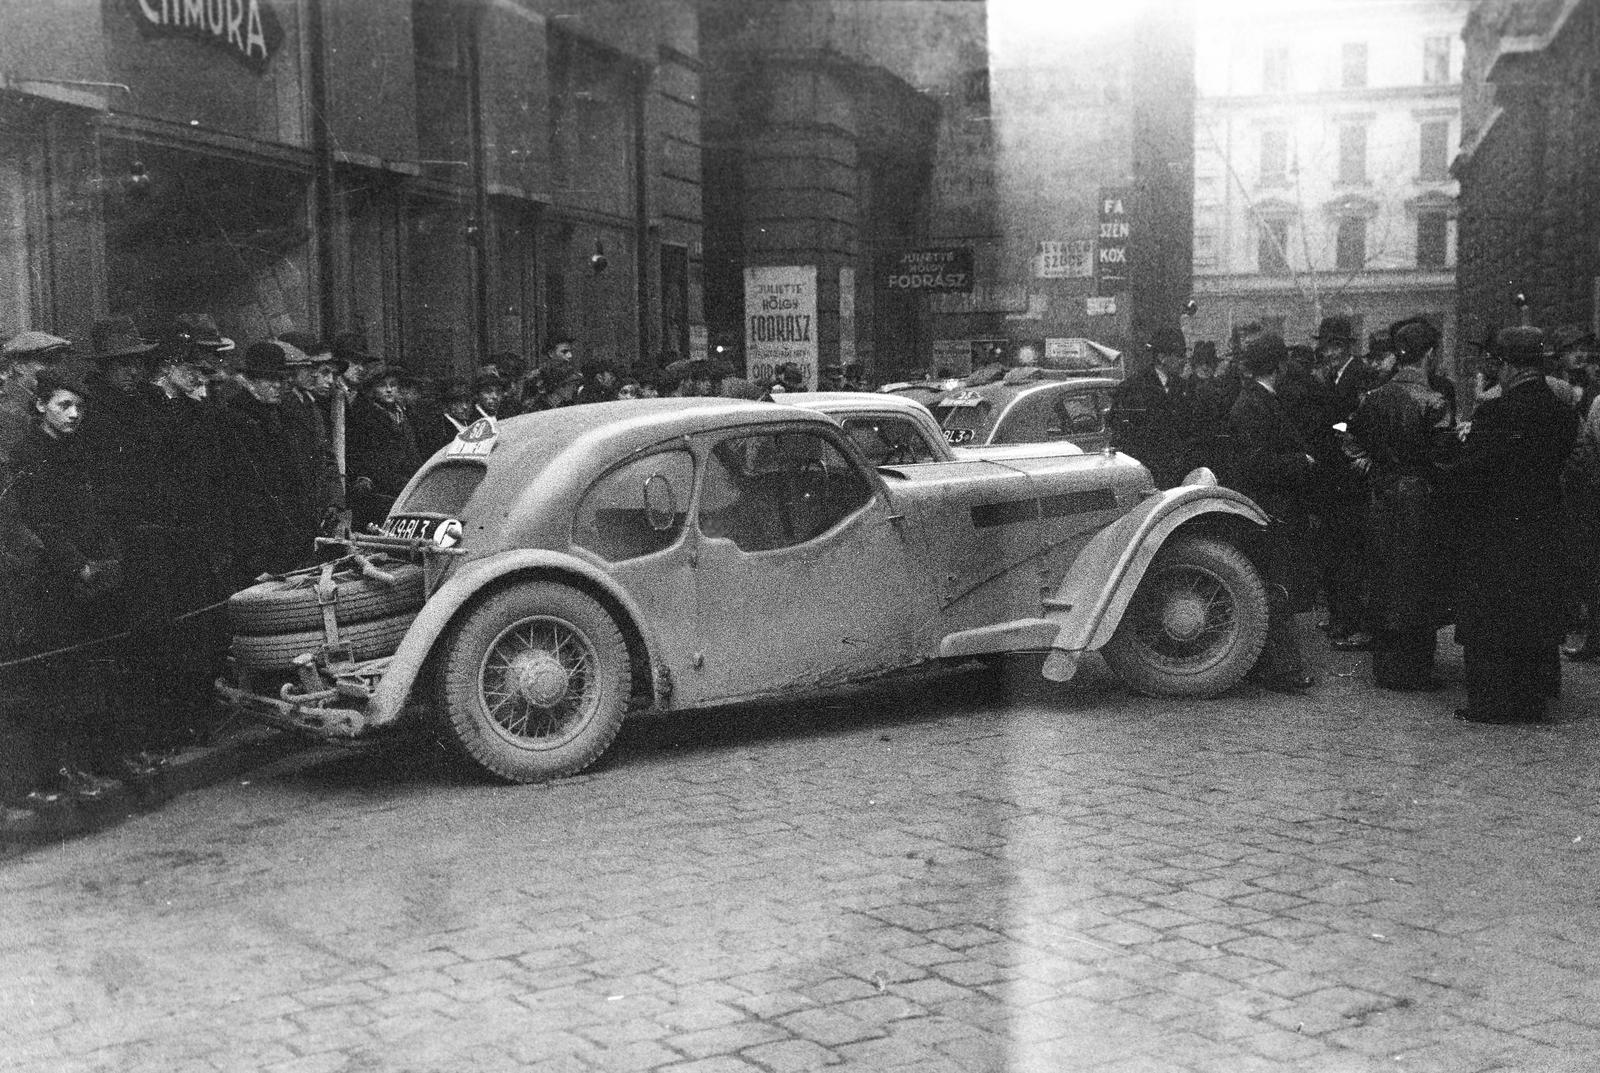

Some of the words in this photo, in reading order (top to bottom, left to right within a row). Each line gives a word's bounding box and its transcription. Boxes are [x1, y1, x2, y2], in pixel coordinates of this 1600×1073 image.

[1104, 199, 1124, 213] FA
[1100, 248, 1126, 262] KOX
[888, 272, 966, 288] FODRÁSZ
